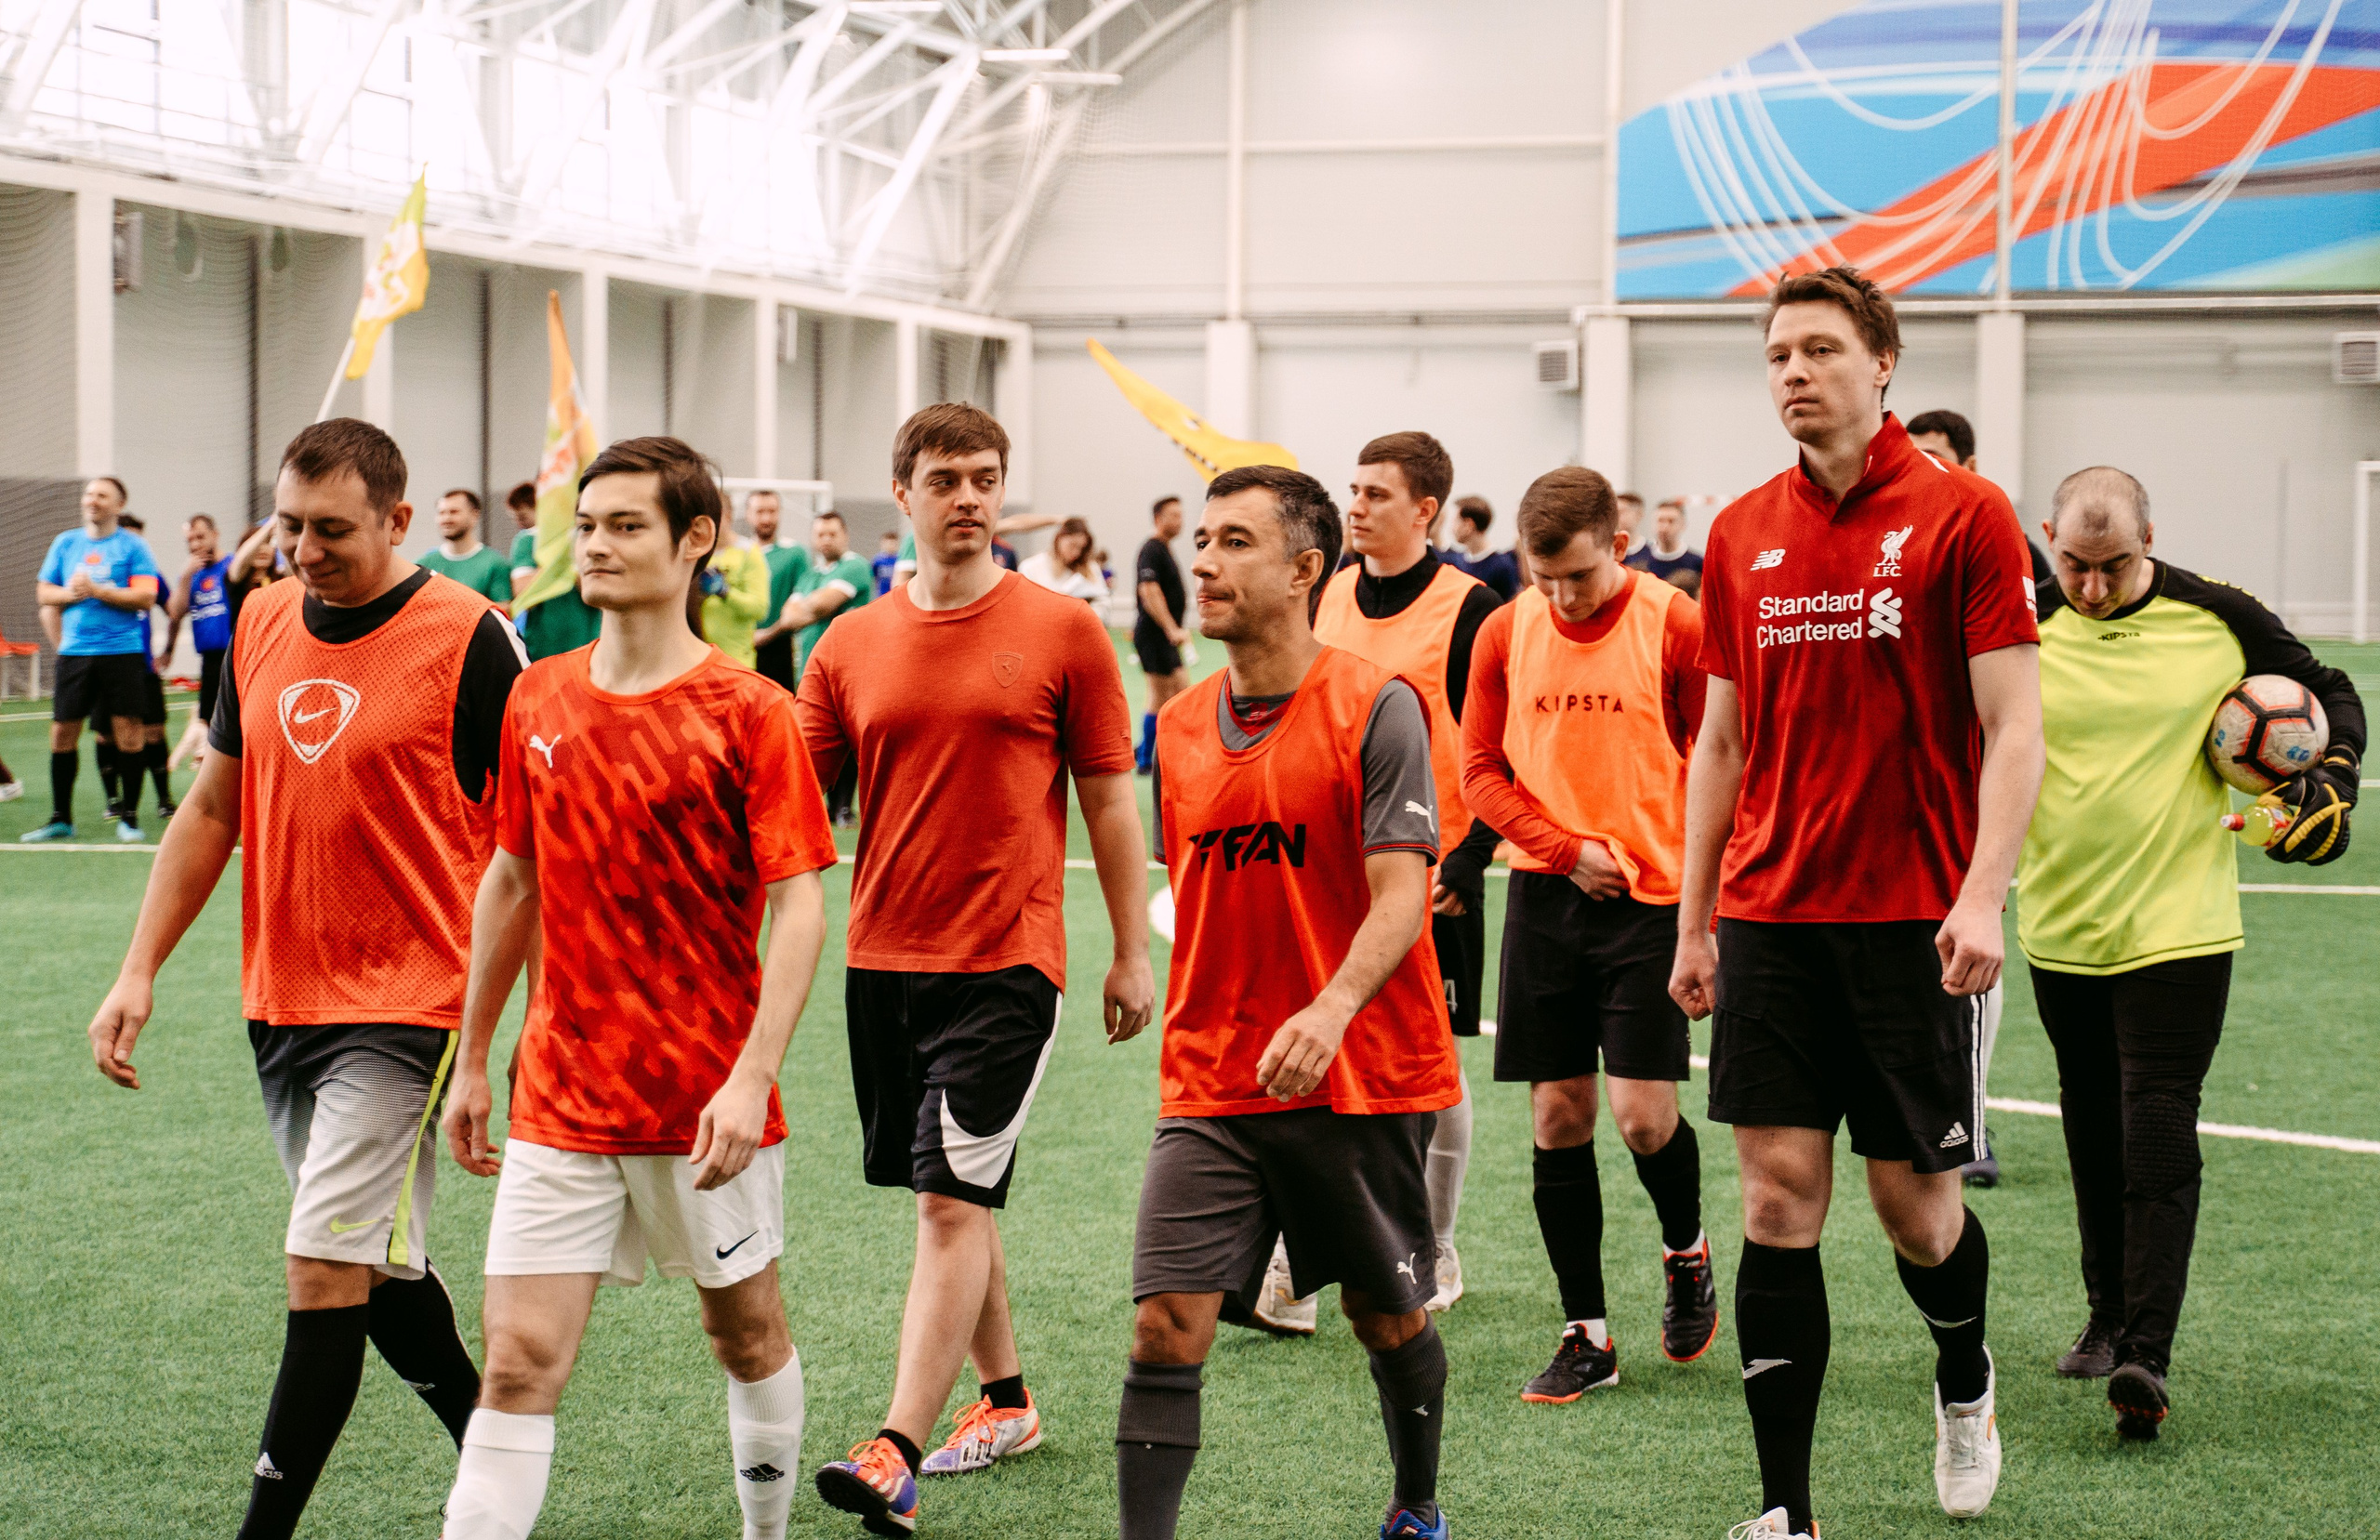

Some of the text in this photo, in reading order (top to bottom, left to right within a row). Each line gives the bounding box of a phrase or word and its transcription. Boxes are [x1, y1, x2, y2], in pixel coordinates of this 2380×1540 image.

[1759, 588, 1865, 619] Standard
[1756, 616, 1863, 649] Chartered
[1535, 694, 1624, 713] KIPSTA
[1939, 1134, 1969, 1149] adidas
